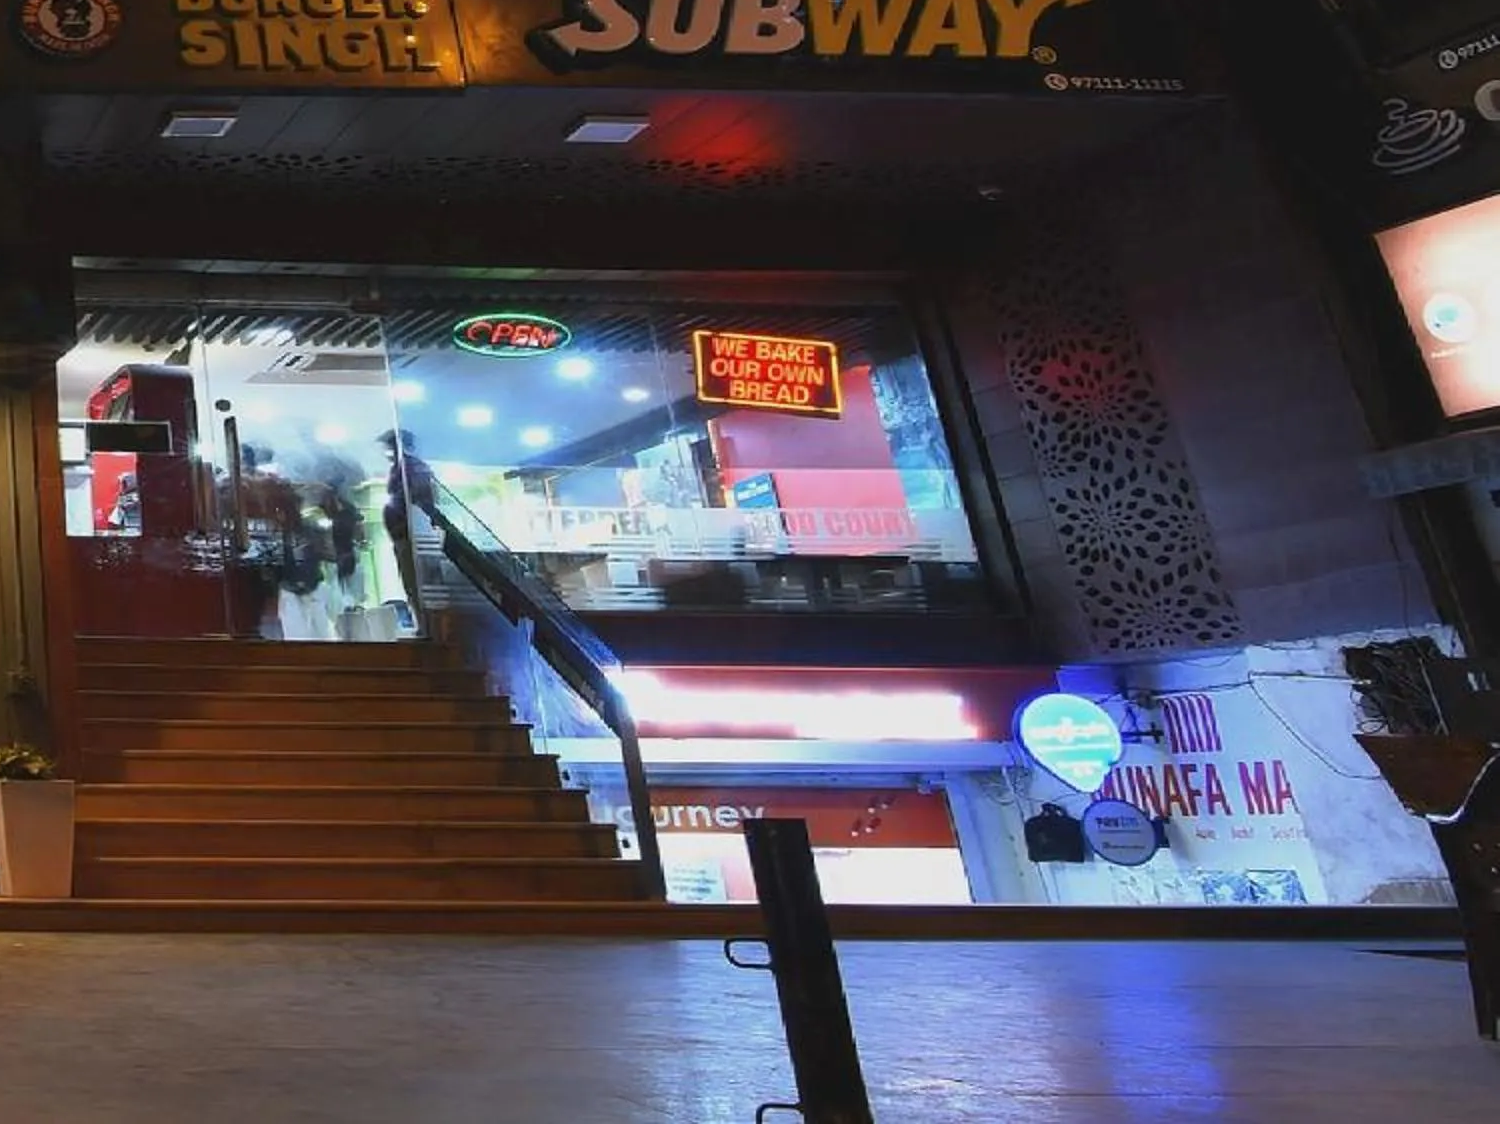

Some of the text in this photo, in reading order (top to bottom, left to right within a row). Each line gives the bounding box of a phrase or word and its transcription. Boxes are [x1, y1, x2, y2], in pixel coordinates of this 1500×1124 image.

[179, 19, 440, 73] SINGH
[467, 321, 560, 348] OPEN
[713, 337, 817, 365] WE BAKE
[710, 358, 825, 385] OUR OWN
[730, 379, 811, 405] BREAD
